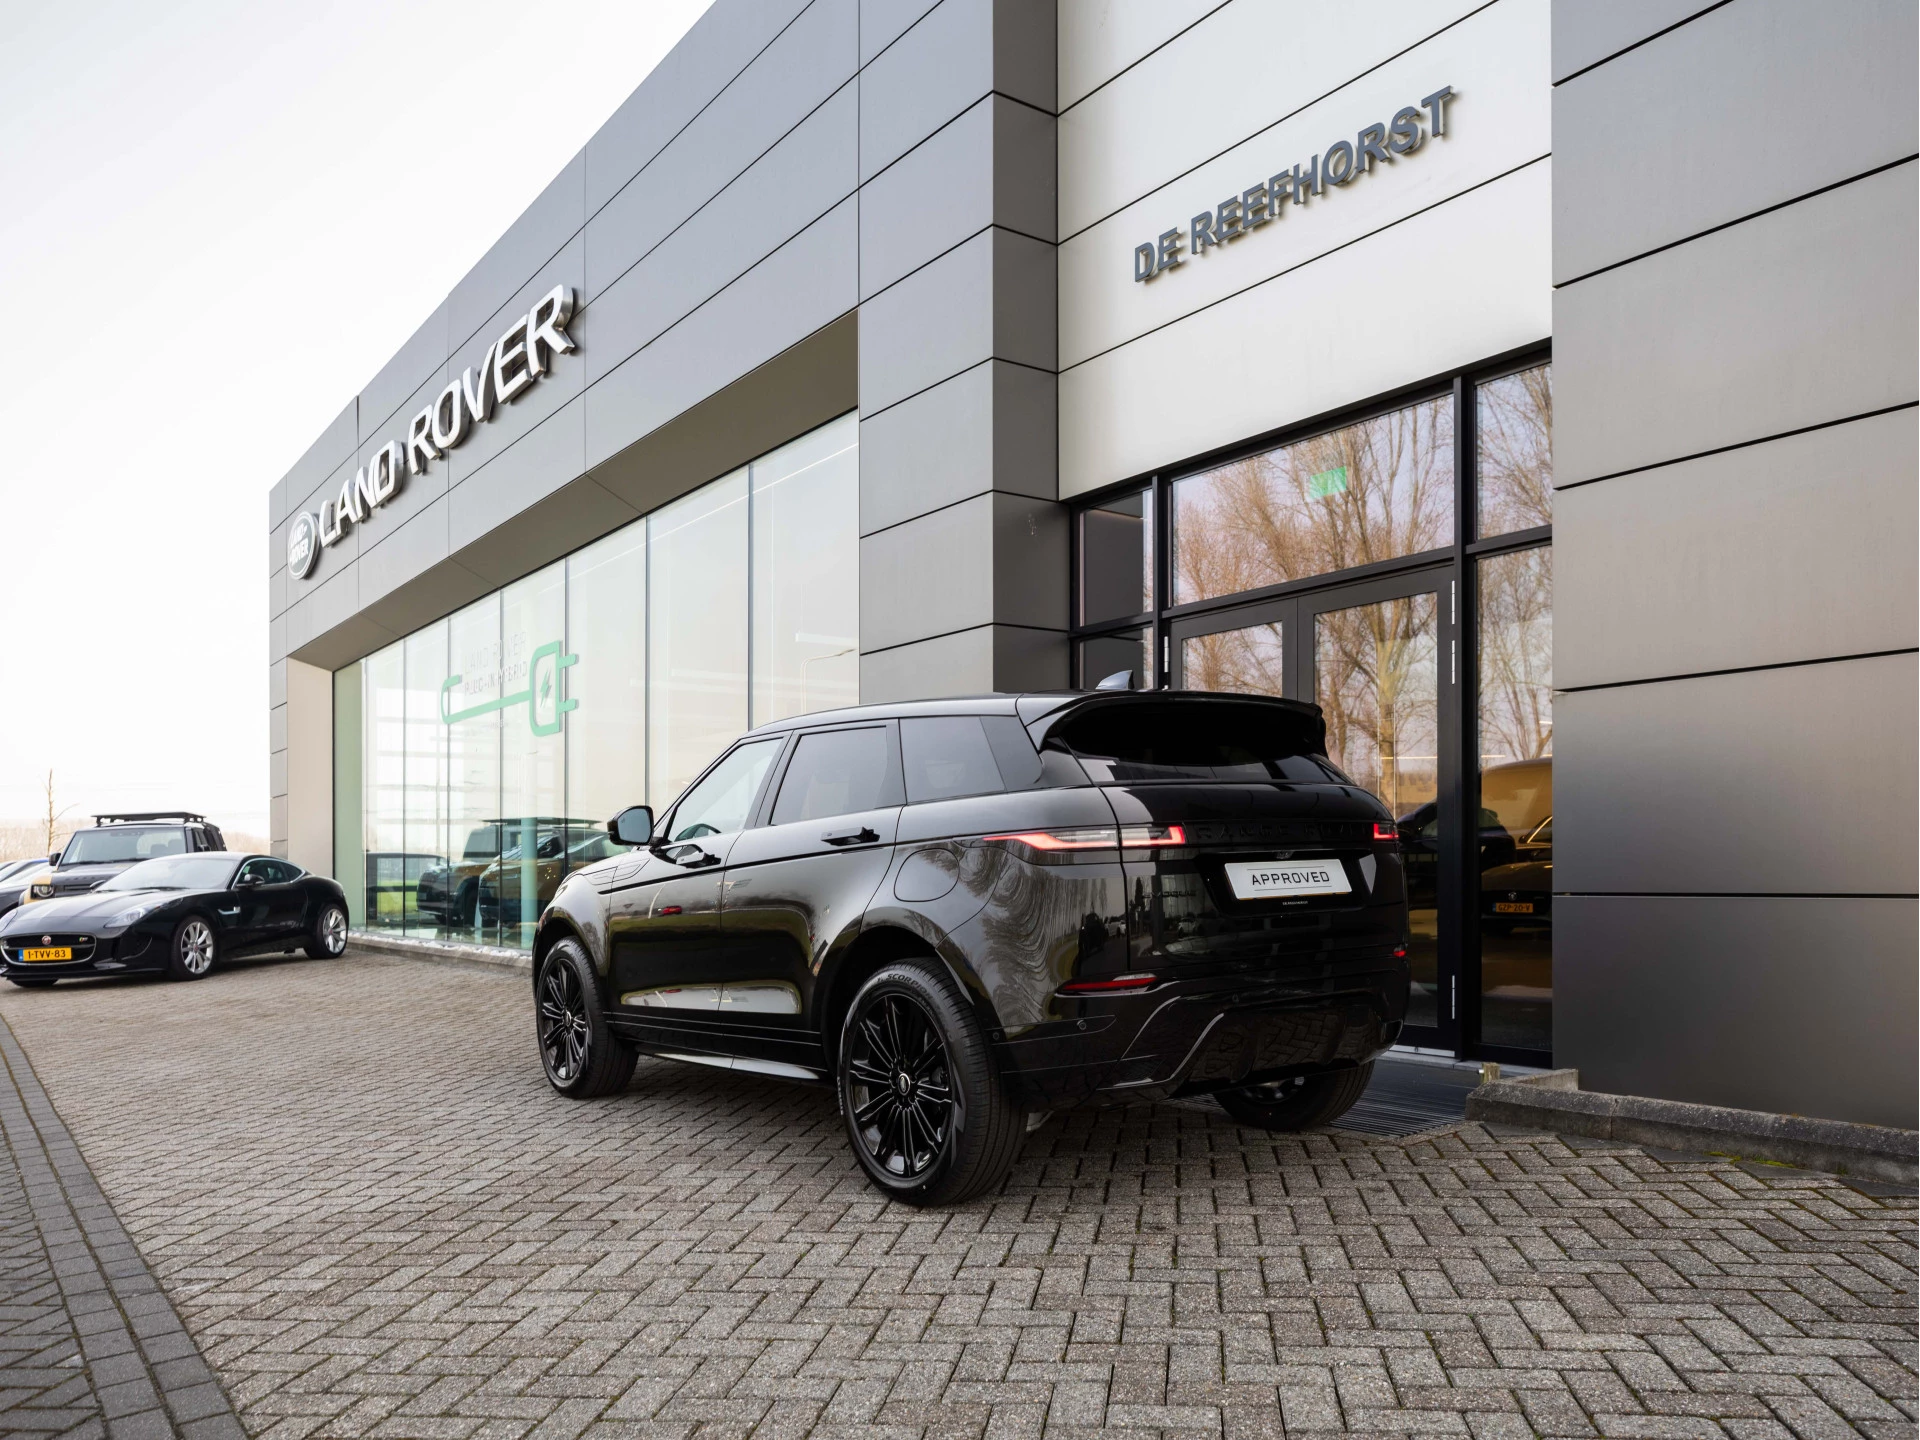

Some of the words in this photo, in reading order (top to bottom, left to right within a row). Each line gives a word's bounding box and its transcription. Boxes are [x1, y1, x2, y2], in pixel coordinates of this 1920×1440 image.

[1134, 226, 1181, 283] DE
[1191, 85, 1454, 255] REEFHORST
[318, 440, 404, 549] LAND
[407, 284, 576, 476] ROVER
[1251, 871, 1331, 886] APPROVED
